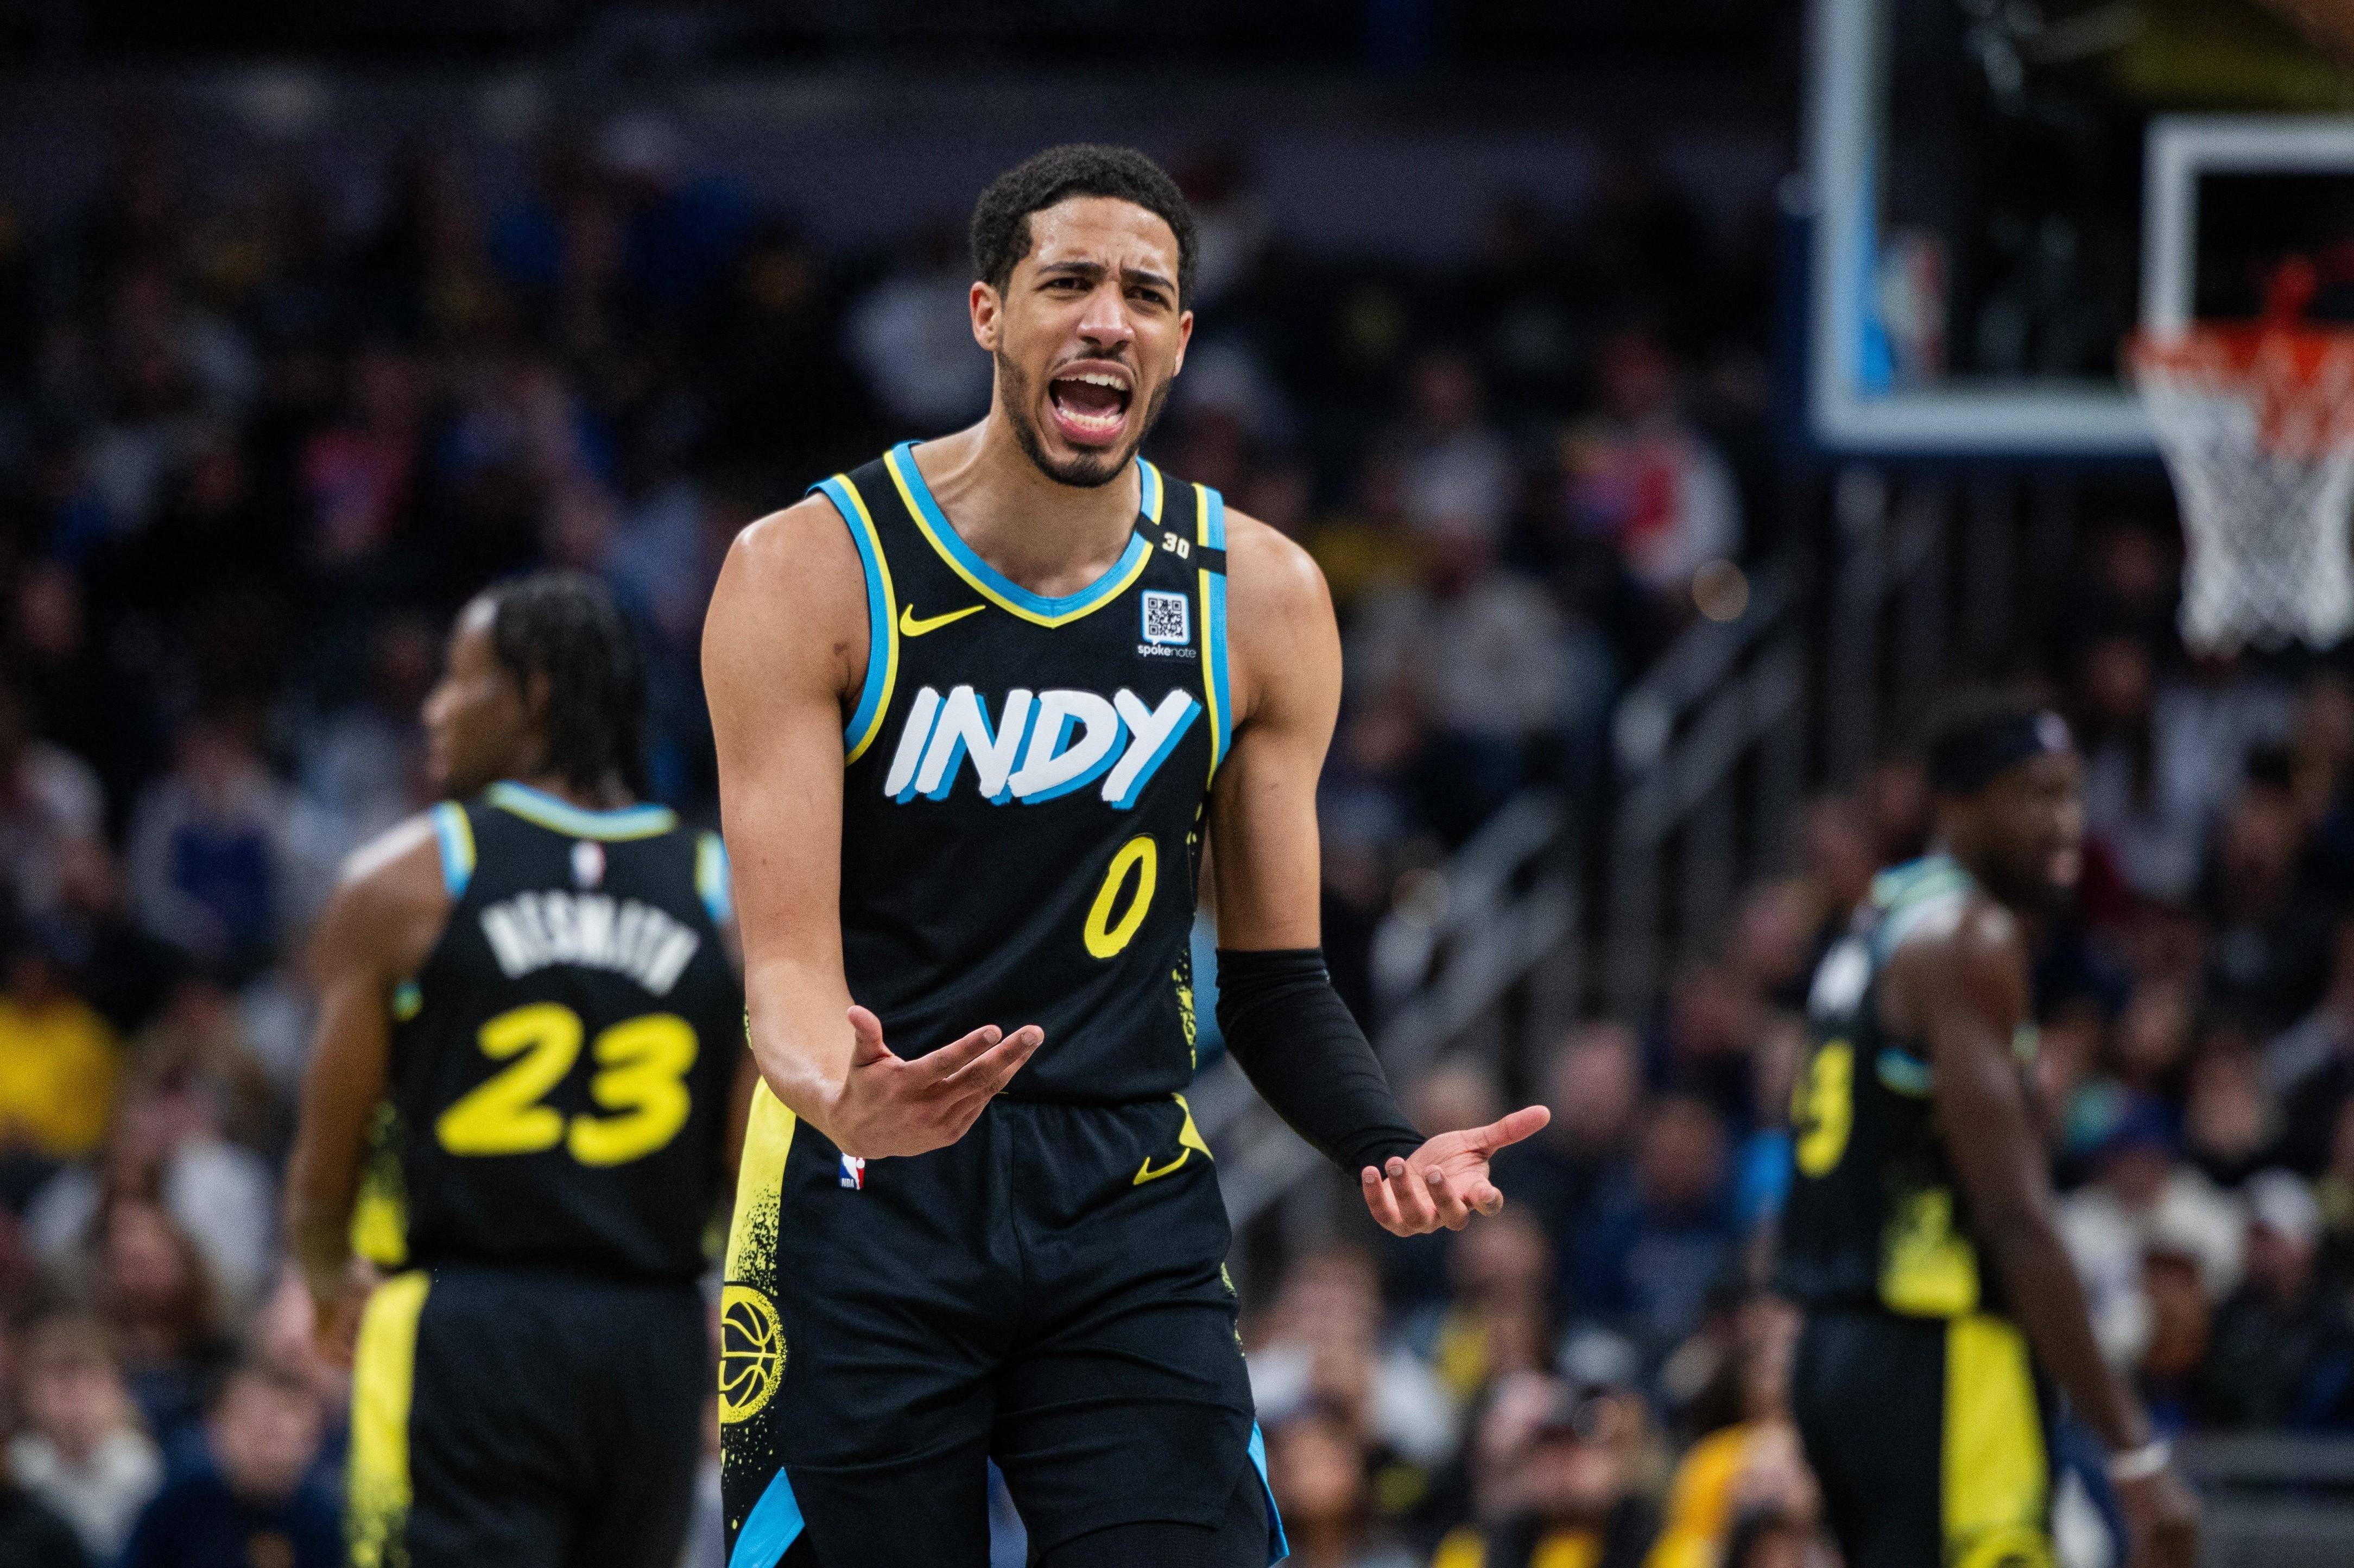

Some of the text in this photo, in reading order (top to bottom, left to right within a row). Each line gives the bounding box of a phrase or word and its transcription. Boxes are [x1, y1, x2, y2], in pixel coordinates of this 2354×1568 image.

[1162, 532, 1190, 560] 30
[1138, 644, 1197, 659] spokenote
[885, 685, 1202, 810] INDY
[1084, 836, 1157, 959] 0
[435, 1001, 700, 1168] 23
